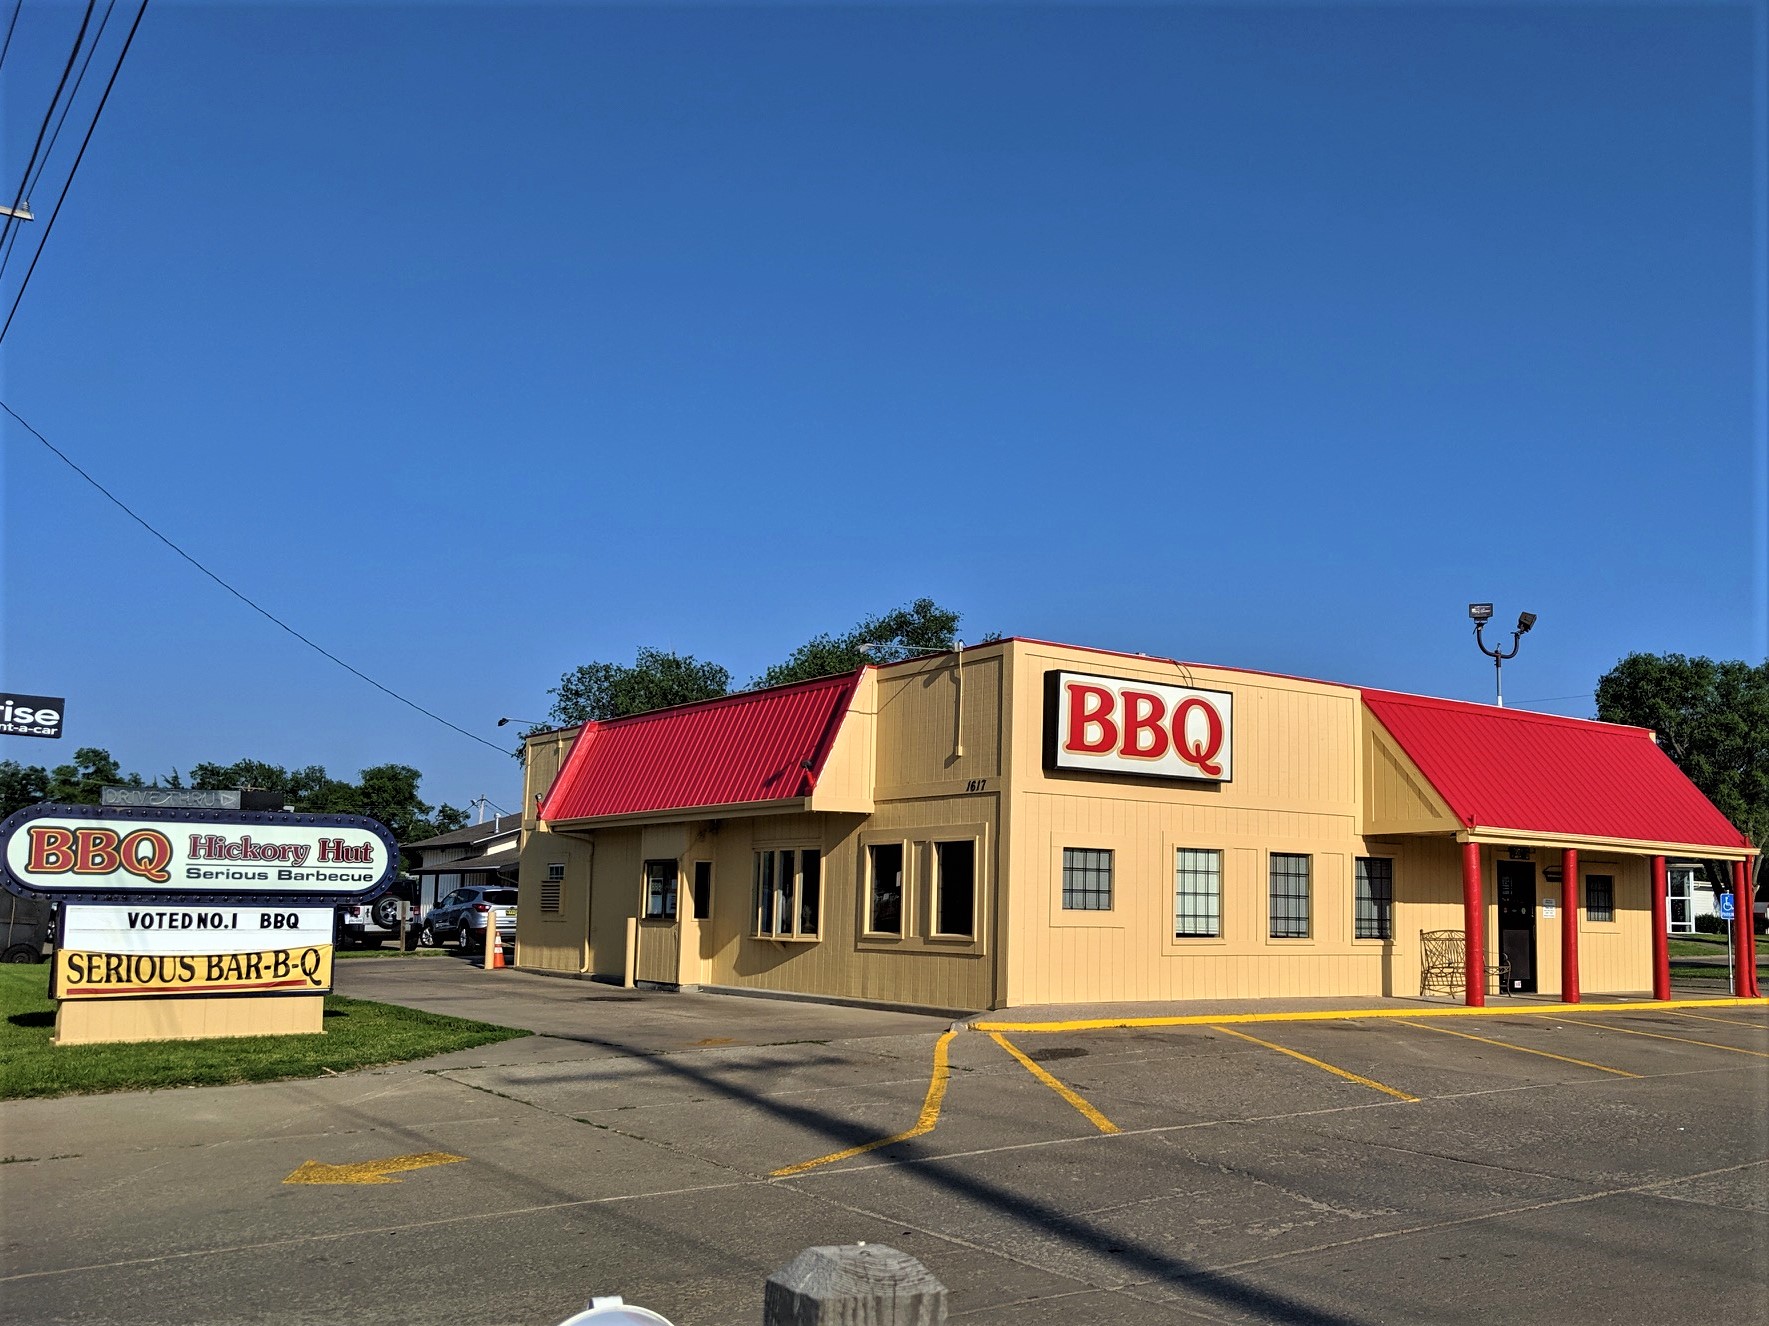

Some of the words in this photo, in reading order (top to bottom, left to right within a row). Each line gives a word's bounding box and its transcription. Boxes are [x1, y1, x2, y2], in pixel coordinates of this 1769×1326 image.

[1064, 681, 1225, 777] BBQ
[966, 779, 987, 792] 1617
[26, 825, 173, 883] BBQ
[189, 834, 311, 867] Hickory
[317, 838, 374, 864] Hut
[185, 867, 269, 881] Serious
[276, 869, 374, 883] Barbecue
[127, 912, 193, 930] VOTED
[260, 912, 300, 930] BBQ
[66, 951, 195, 984] SERIOUS
[205, 947, 323, 986] BAR-B-Q
